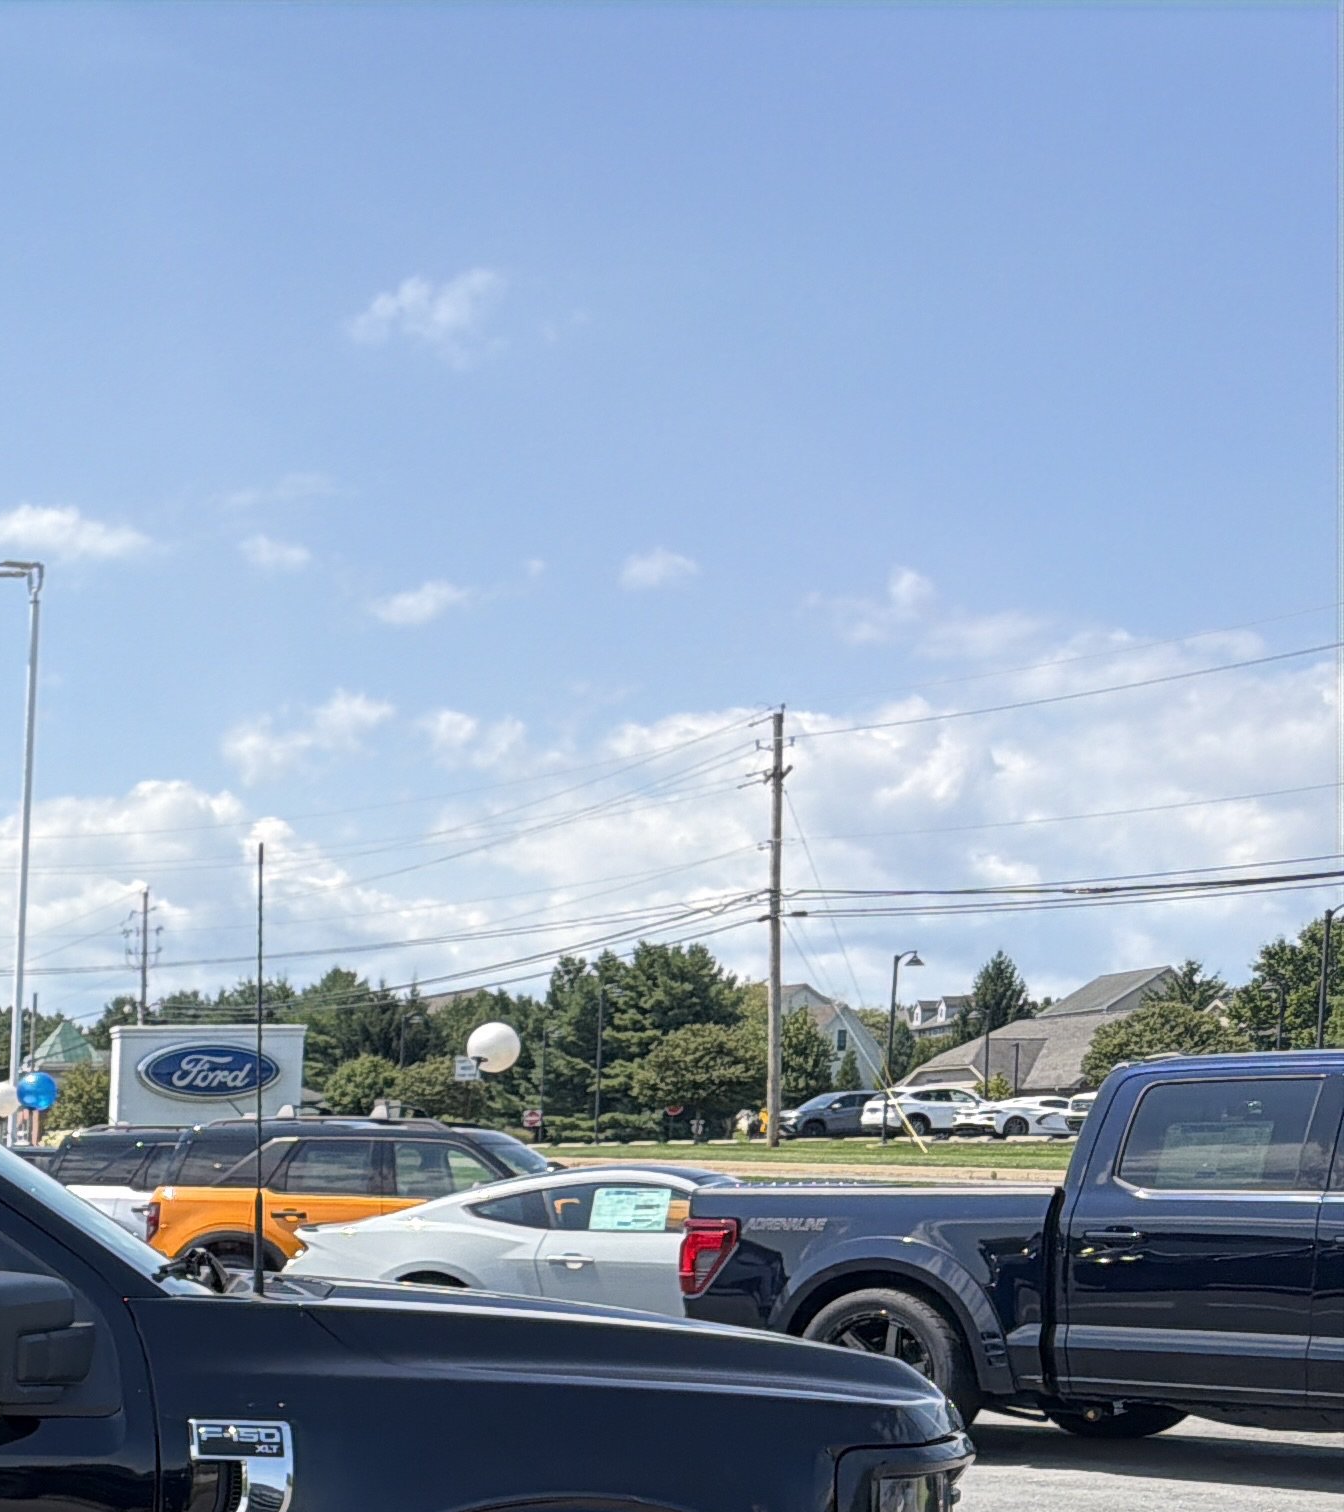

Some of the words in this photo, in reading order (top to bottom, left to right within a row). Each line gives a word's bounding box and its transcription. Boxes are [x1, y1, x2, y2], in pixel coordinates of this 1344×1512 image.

[171, 1054, 252, 1087] Ford
[198, 1425, 282, 1443] F-150
[254, 1444, 281, 1454] XLT
